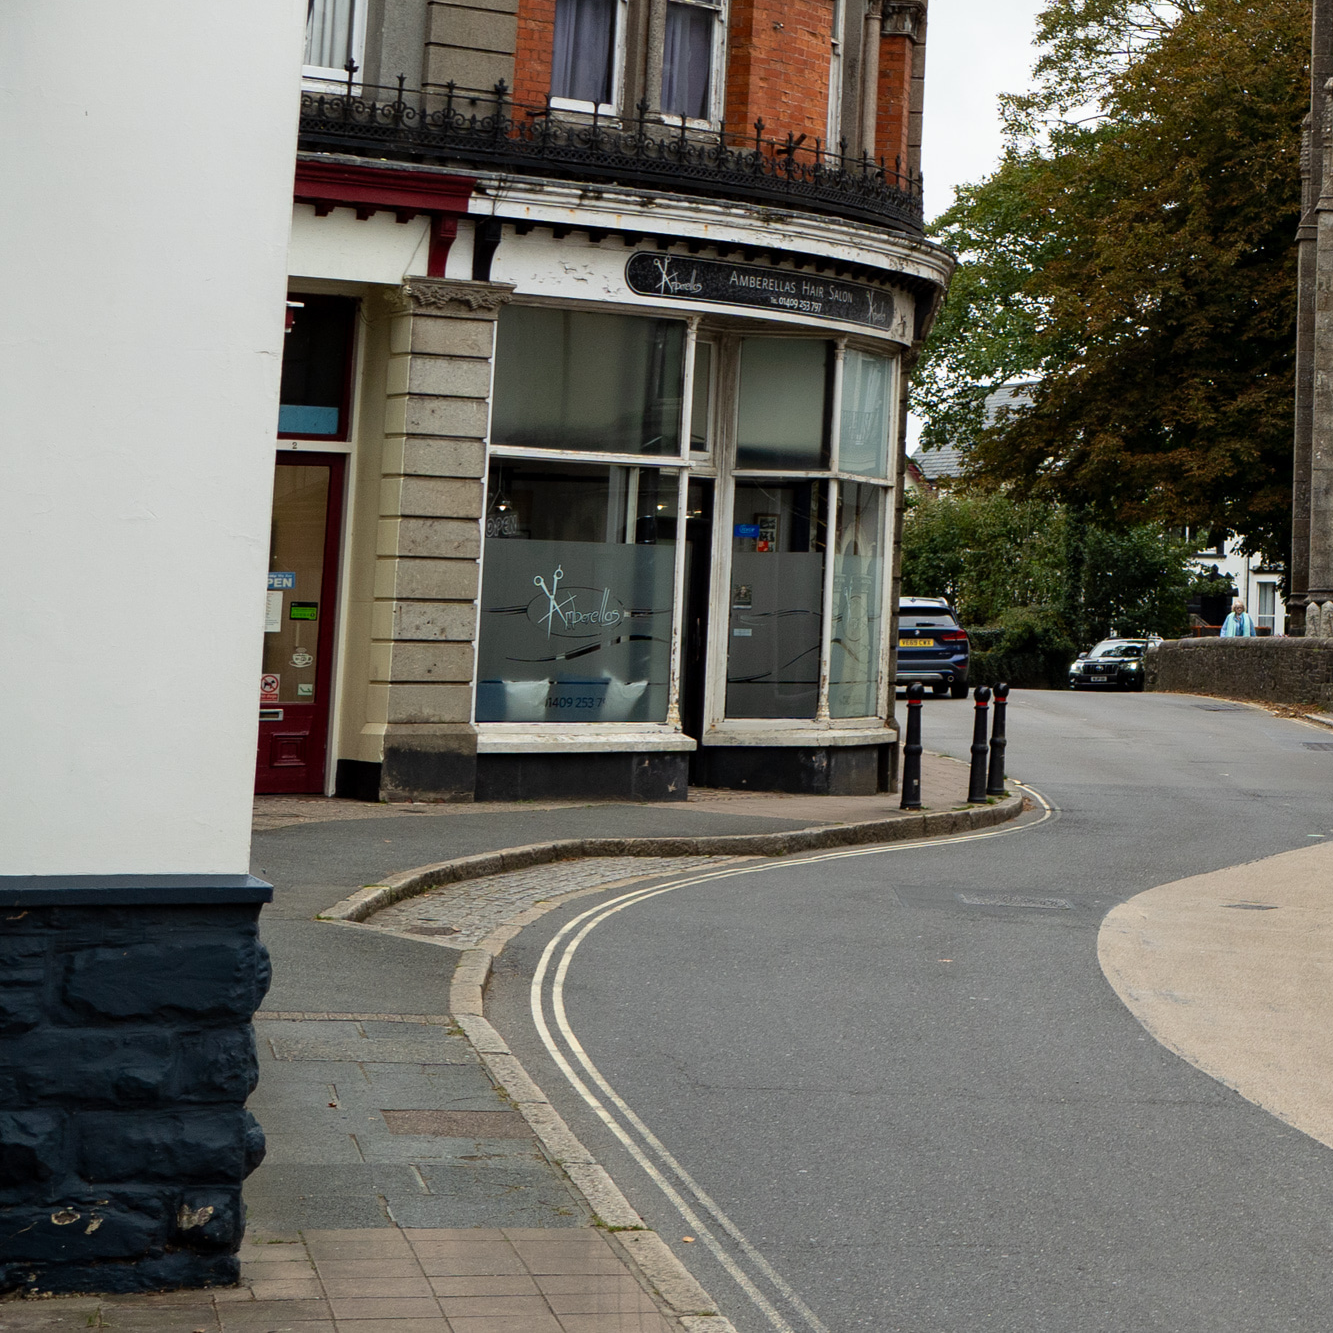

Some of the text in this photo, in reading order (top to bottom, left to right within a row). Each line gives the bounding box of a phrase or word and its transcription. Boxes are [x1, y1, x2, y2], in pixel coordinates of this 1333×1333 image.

[729, 270, 796, 294] AMBERELLAS
[778, 297, 798, 309] 01409
[799, 299, 810, 312] 253
[811, 301, 822, 313] 797
[486, 514, 518, 538] OPEN
[268, 577, 292, 588] PEN
[575, 697, 594, 708] 253
